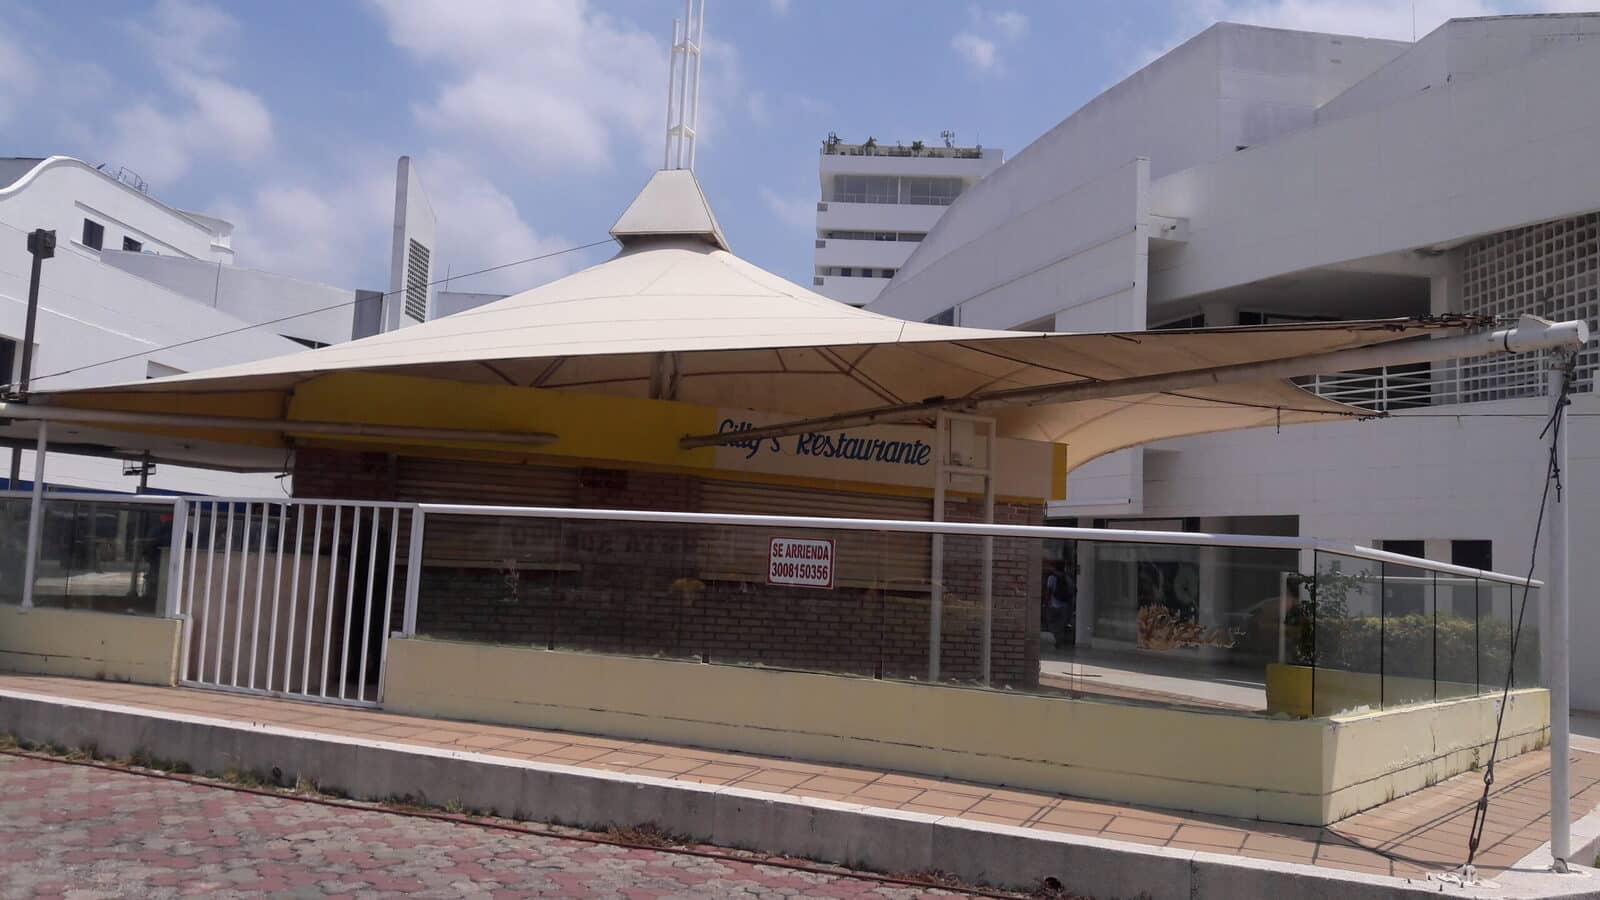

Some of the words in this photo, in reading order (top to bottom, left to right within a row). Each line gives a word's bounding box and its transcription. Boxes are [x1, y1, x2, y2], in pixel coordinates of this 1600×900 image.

[719, 419, 781, 458] Cillys
[797, 432, 931, 466] Restaurante
[772, 543, 784, 558] SE
[785, 544, 829, 561] ARRIENDA
[772, 562, 828, 580] 3008150356
